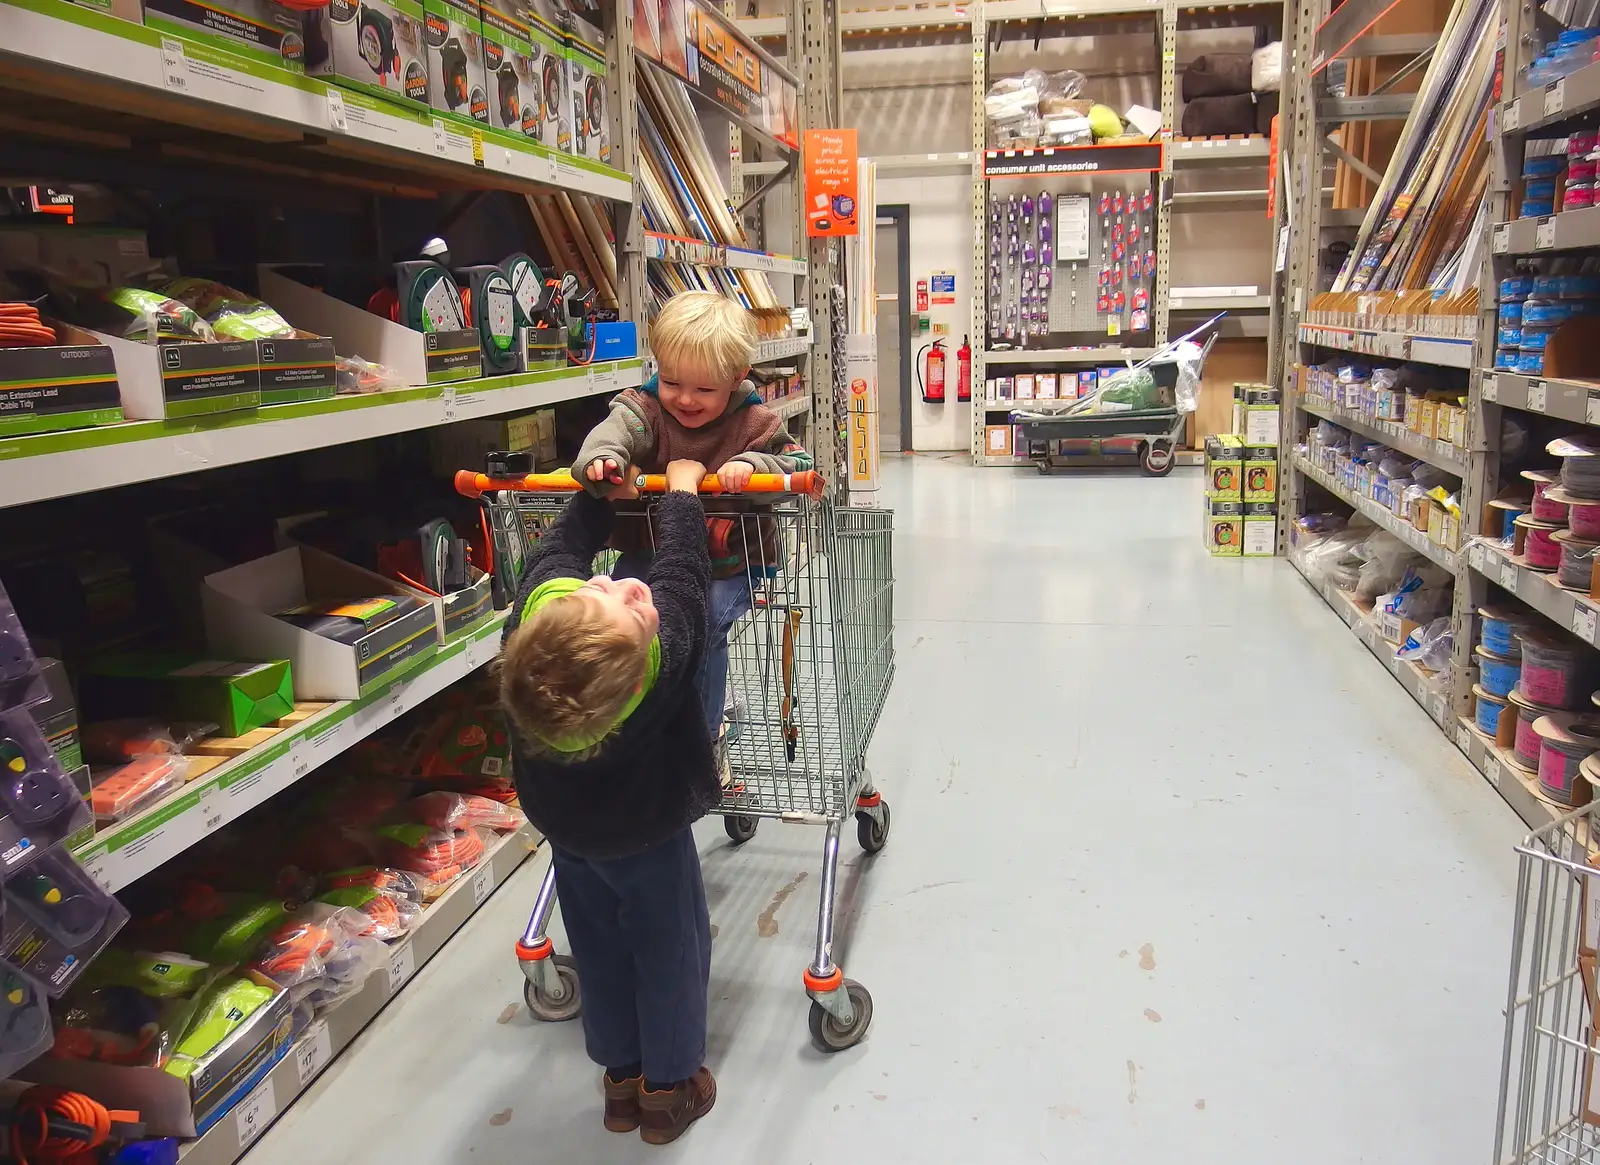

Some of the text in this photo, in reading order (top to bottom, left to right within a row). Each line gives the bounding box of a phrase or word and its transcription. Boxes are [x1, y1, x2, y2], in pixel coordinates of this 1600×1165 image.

[212, 11, 225, 22] Metre
[225, 14, 246, 29] Extension
[246, 22, 256, 32] Lead
[204, 19, 259, 42] with Weatherproof Socket
[428, 26, 441, 36] TOOLS
[410, 86, 425, 98] TOOLS
[475, 108, 487, 120] TOOLS
[822, 148, 842, 157] prices
[815, 166, 849, 175] electrical
[986, 162, 1098, 174] consumer unit accessories
[822, 179, 840, 190] range
[216, 380, 229, 388] Outdoor
[229, 378, 245, 386] Equipment
[10, 390, 42, 400] Extension
[42, 388, 58, 397] Lead
[0, 400, 34, 410] Cable Tidy
